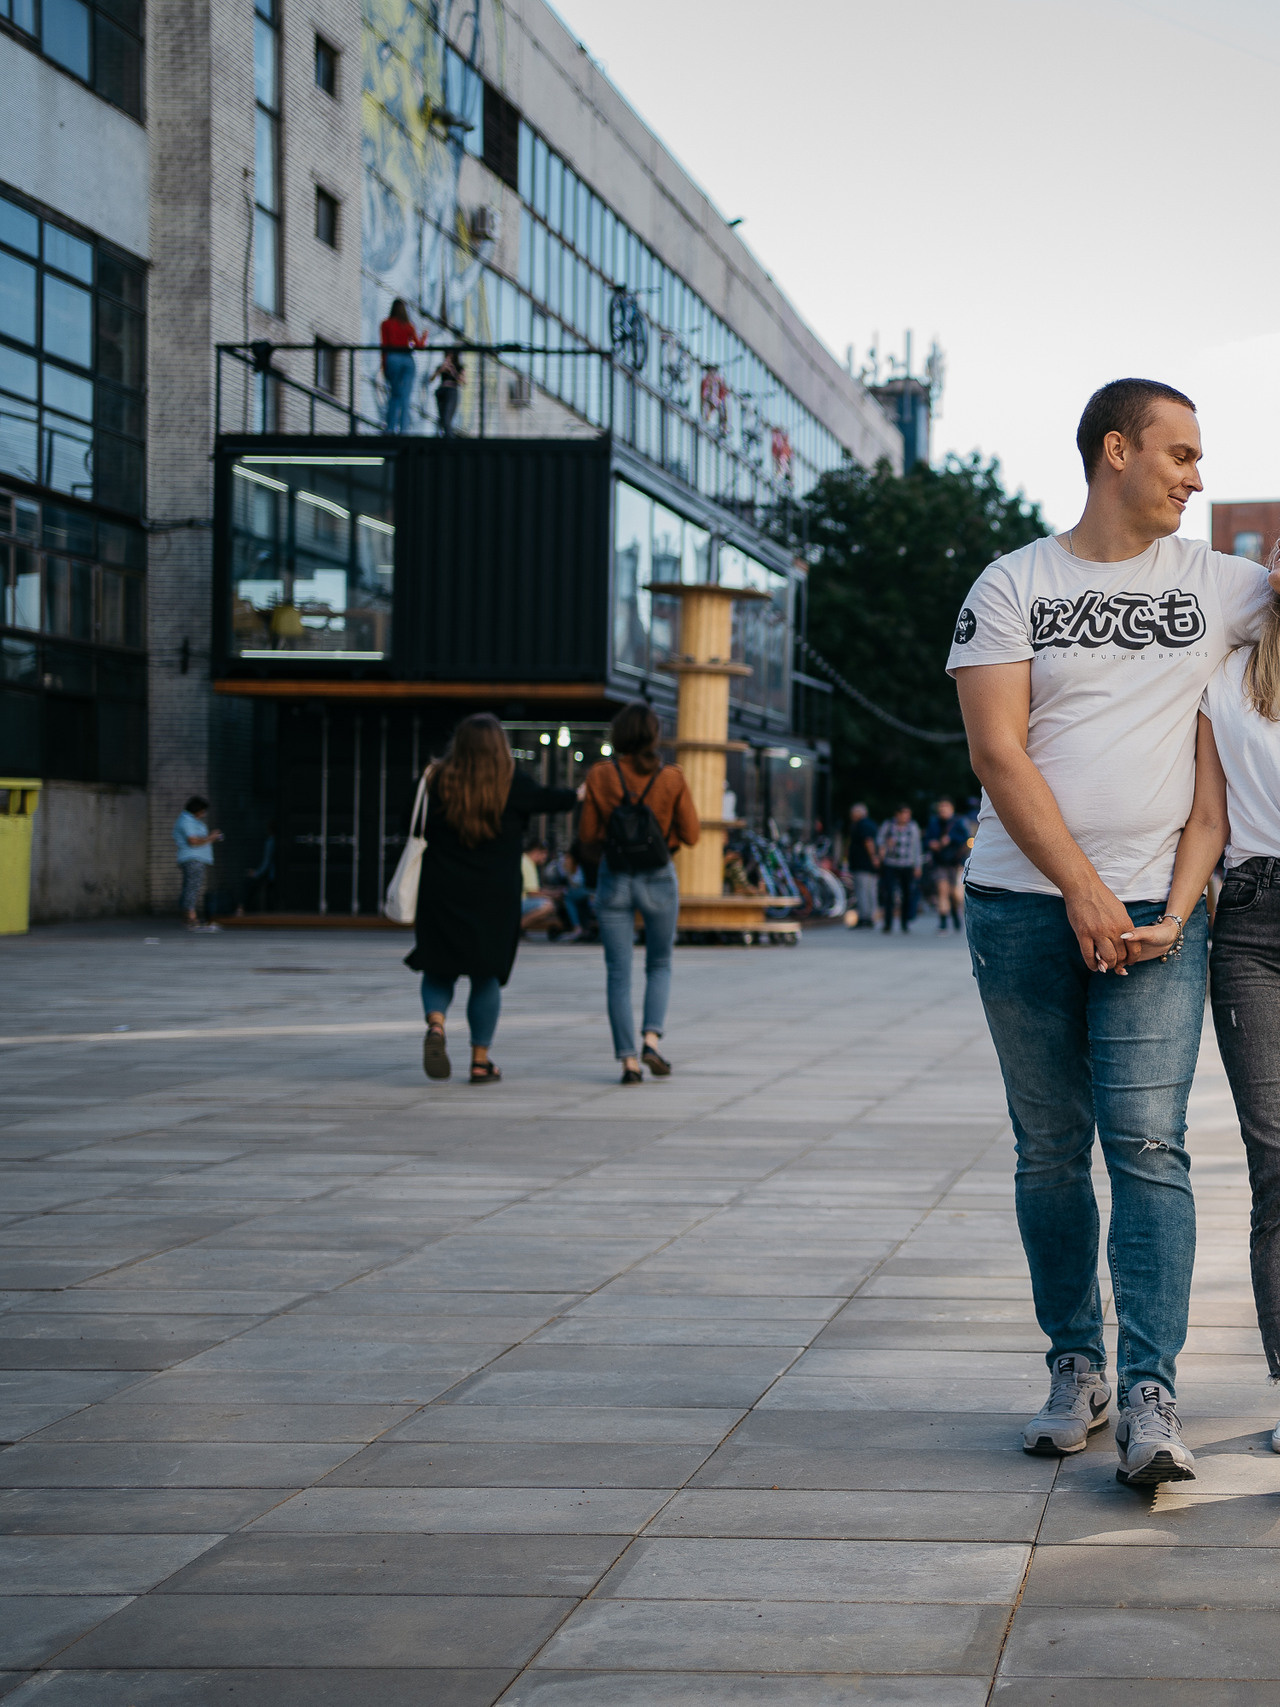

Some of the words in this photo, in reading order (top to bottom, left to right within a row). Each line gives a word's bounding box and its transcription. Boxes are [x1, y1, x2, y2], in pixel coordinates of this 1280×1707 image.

[1031, 589, 1206, 650] なんでも
[1035, 652, 1079, 661] TEVER
[1091, 653, 1146, 661] FUTURE
[1158, 651, 1208, 659] BRINGS
